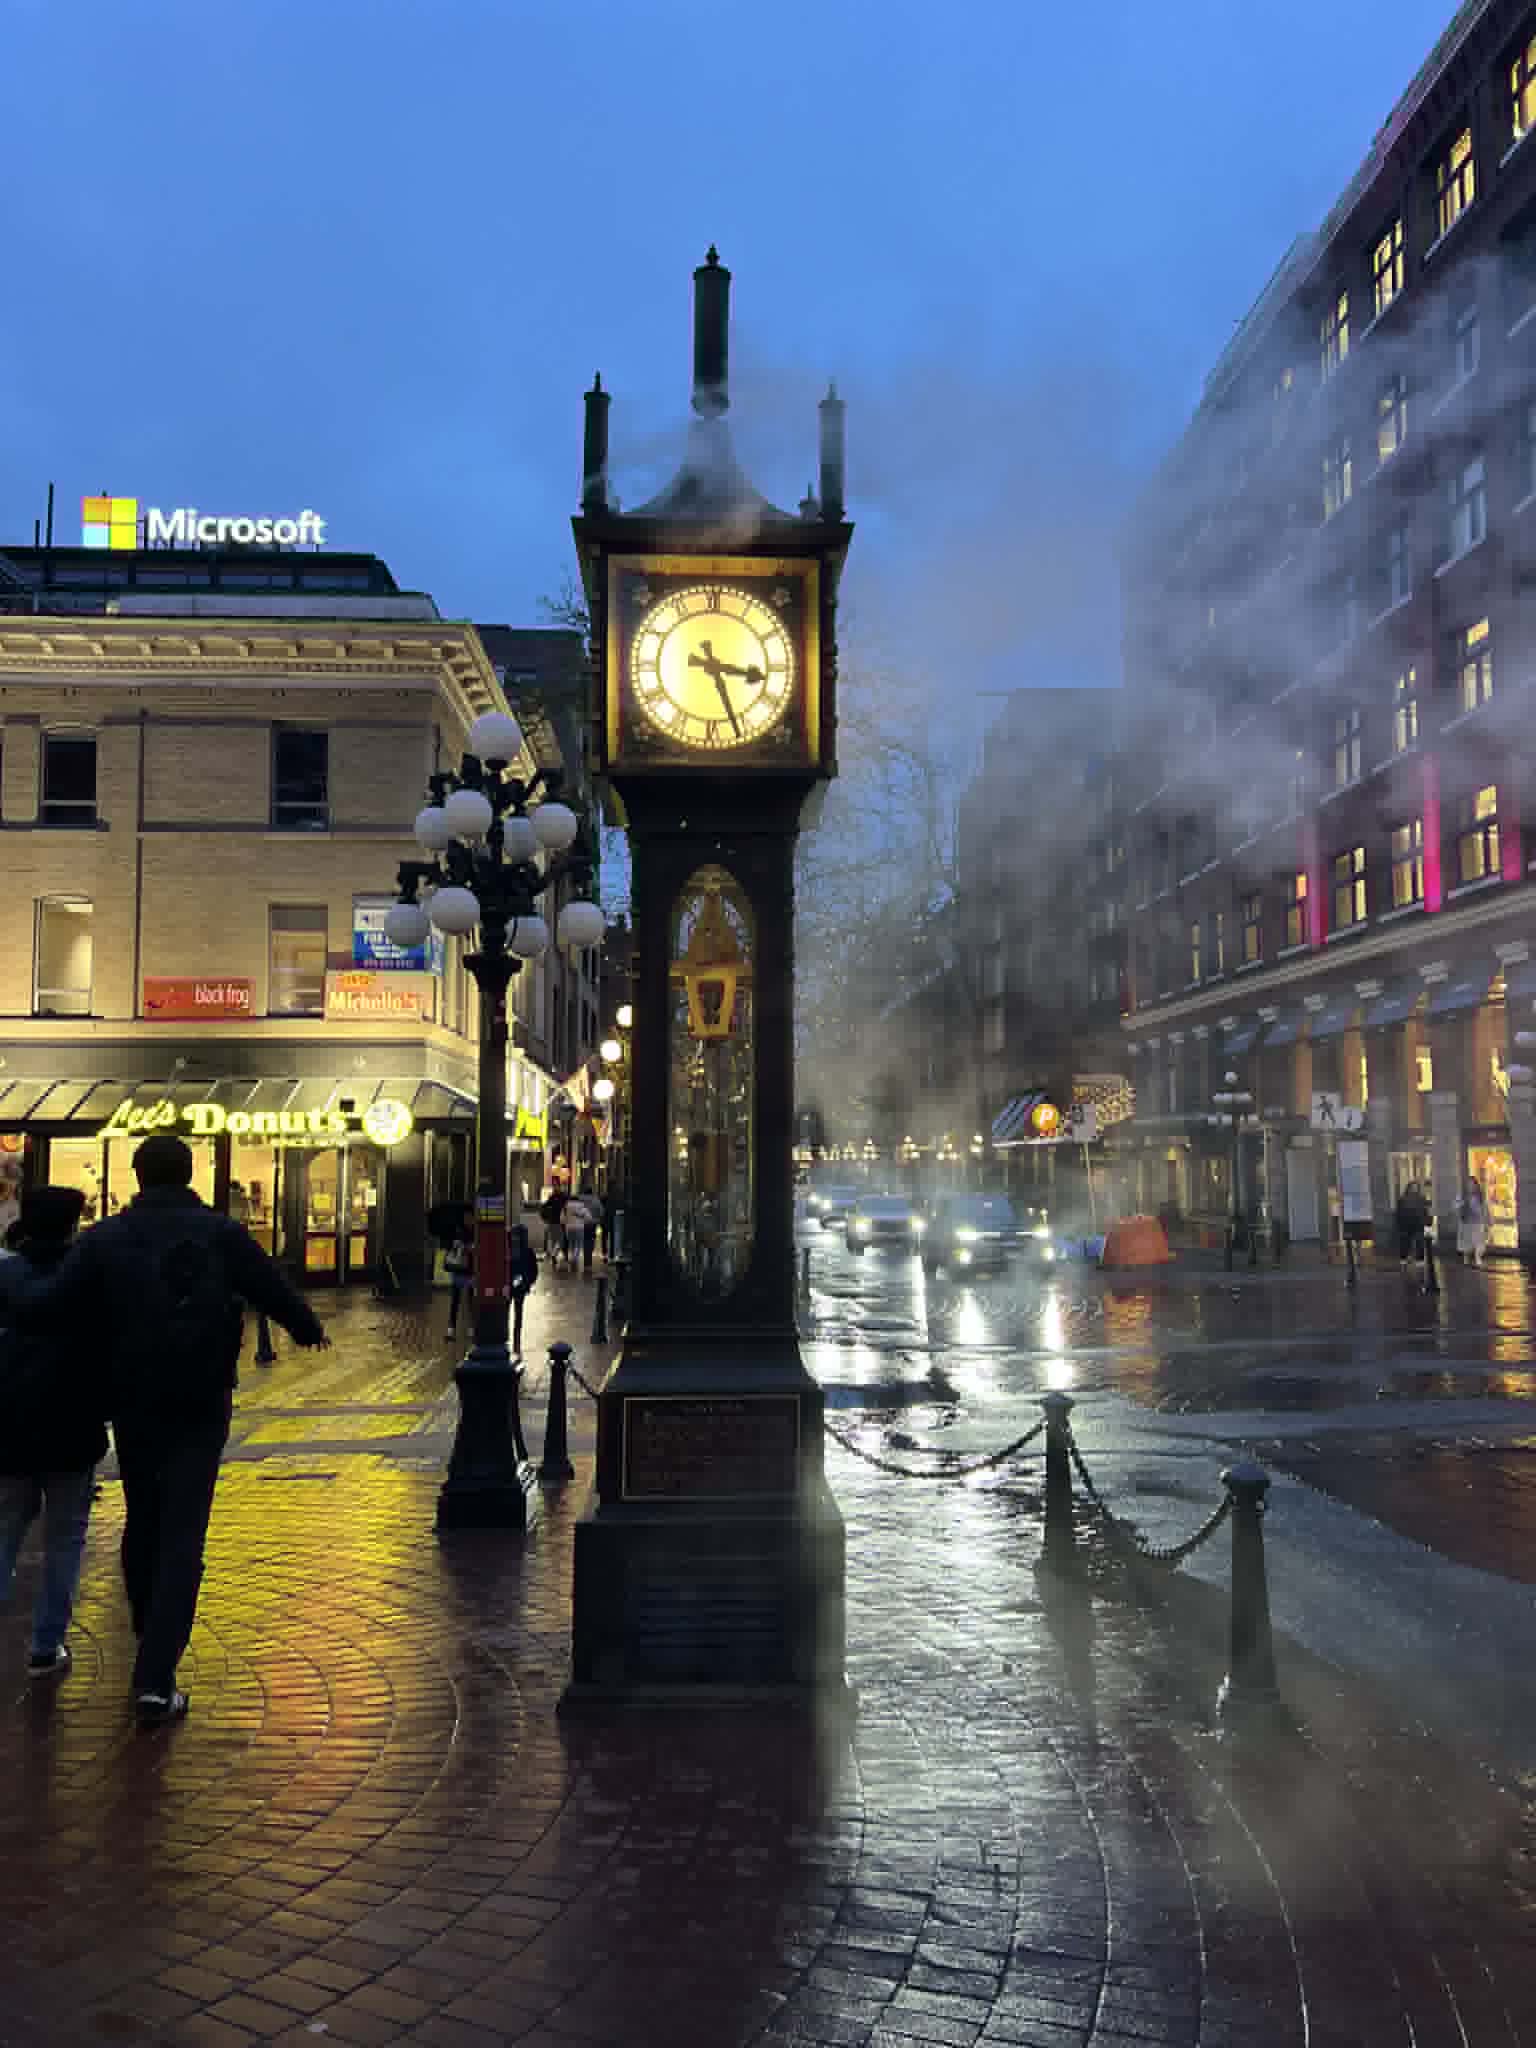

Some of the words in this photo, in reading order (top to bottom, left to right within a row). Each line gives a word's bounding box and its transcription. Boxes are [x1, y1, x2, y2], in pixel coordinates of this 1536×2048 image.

[147, 508, 325, 543] Microsoft
[194, 983, 225, 1005] black
[226, 983, 249, 1010] frog
[97, 1098, 177, 1137] Lee's
[182, 1102, 347, 1135] Donuts
